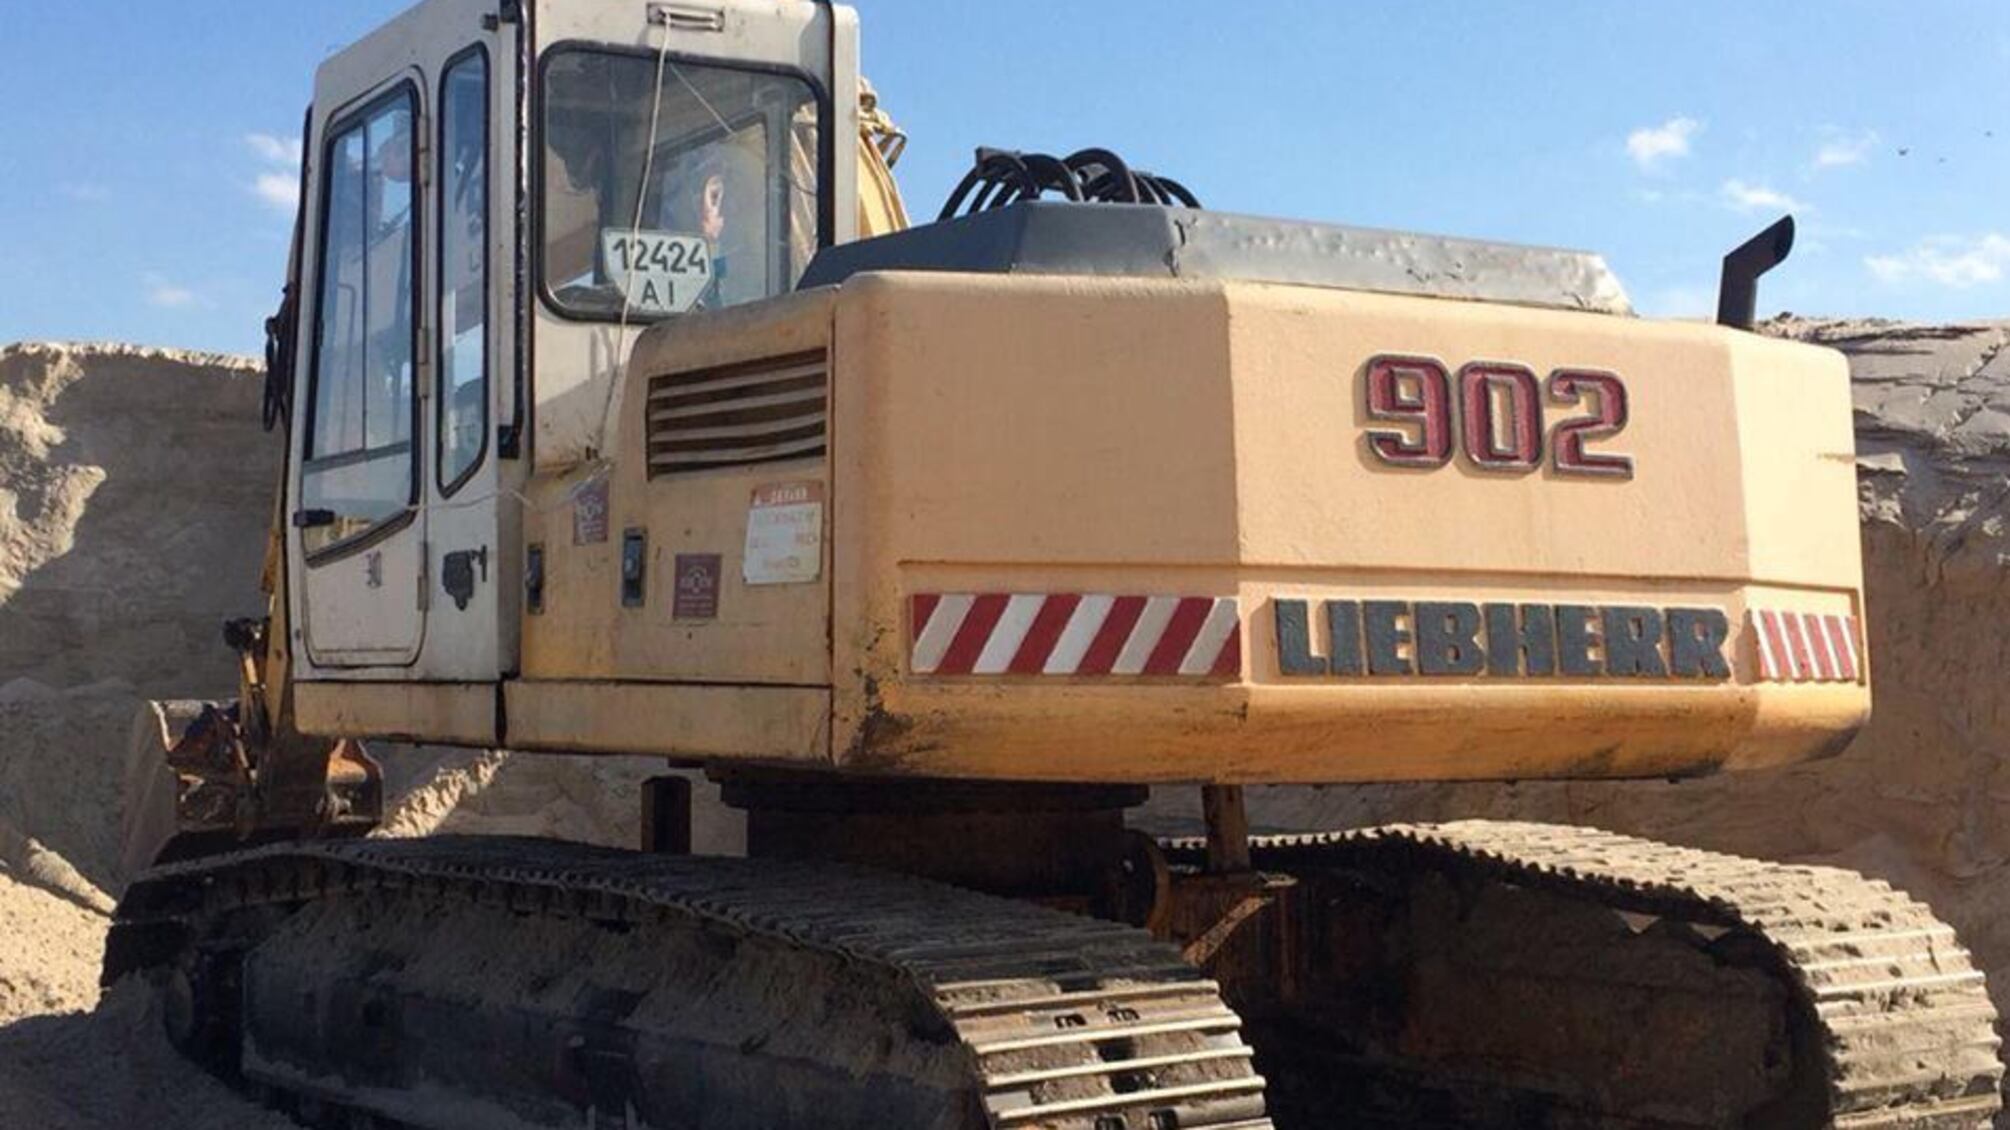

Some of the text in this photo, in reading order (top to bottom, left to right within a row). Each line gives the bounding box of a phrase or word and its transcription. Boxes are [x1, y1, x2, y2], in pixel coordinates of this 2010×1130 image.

[613, 238, 706, 274] 12424
[1365, 354, 1634, 479] 902
[1275, 598, 1732, 679] LIEBHERR
